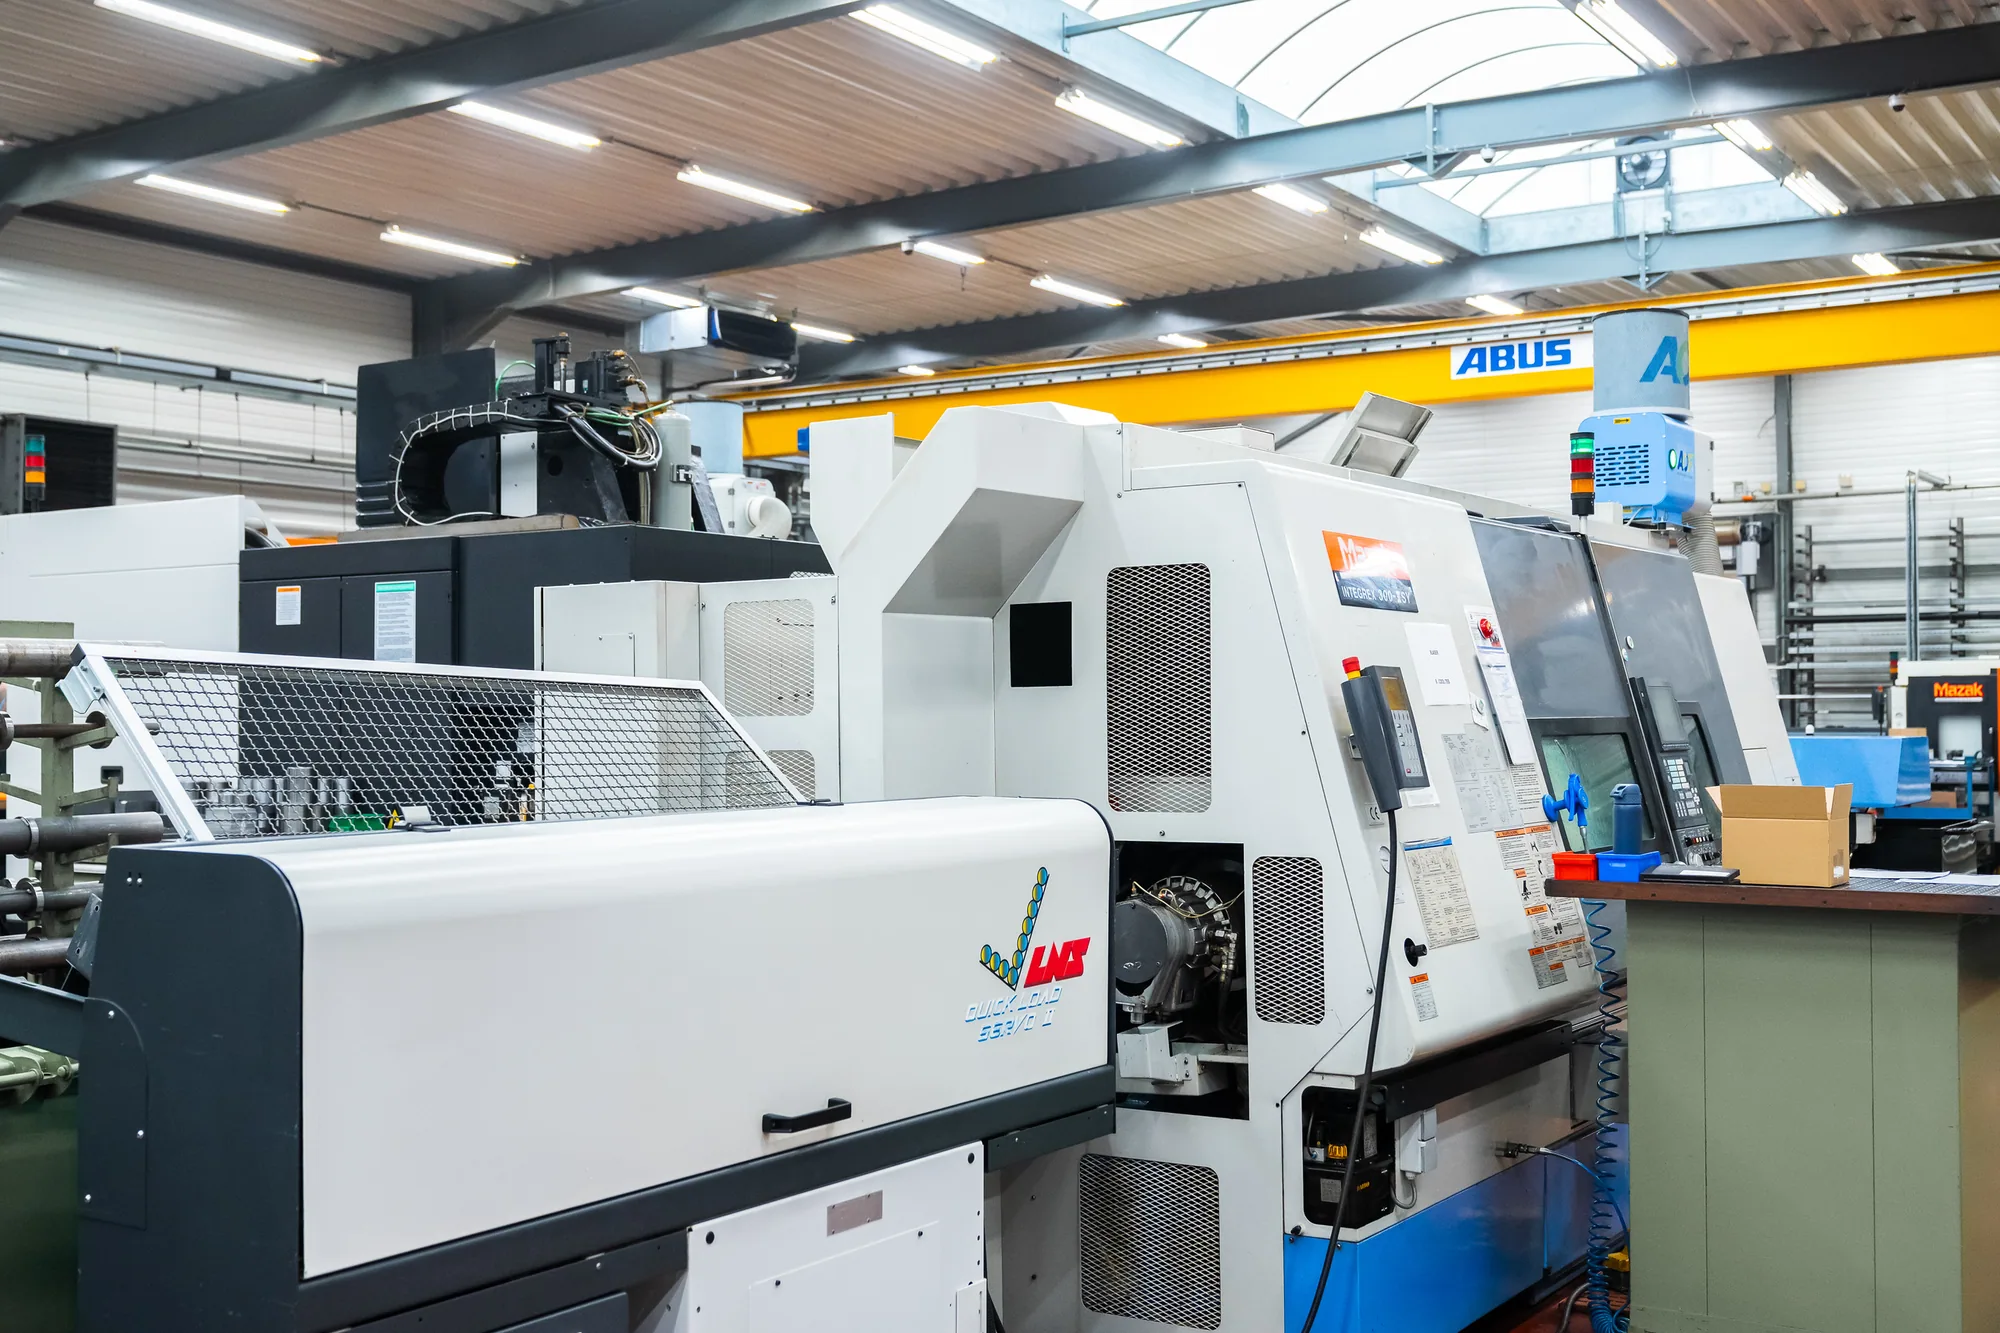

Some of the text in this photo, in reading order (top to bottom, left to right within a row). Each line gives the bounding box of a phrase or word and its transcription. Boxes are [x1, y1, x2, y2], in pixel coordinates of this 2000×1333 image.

[1456, 338, 1571, 375] ABUS
[1341, 585, 1376, 600] INTEGREX
[1933, 681, 1984, 698] Mazak
[1023, 937, 1091, 988] LNS
[965, 987, 1062, 1022] QUICK LOAD
[978, 1012, 1036, 1042] SERVO
